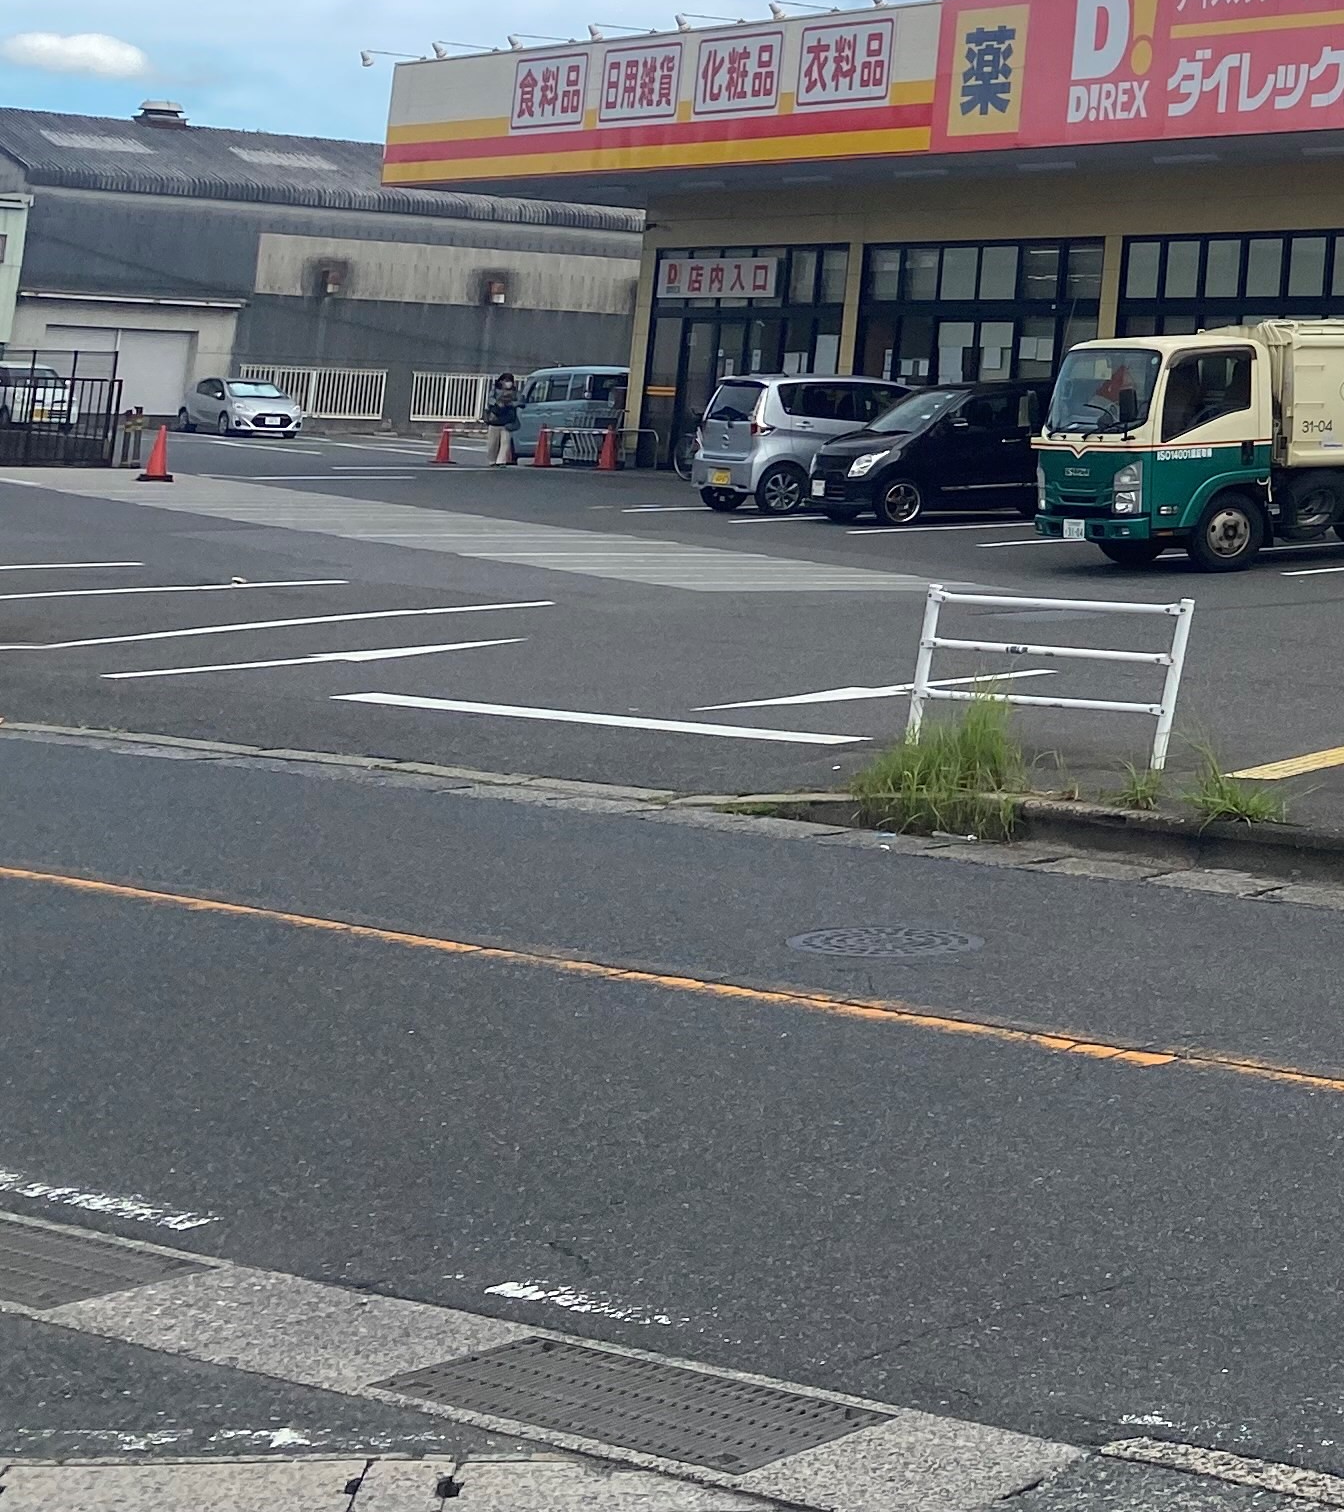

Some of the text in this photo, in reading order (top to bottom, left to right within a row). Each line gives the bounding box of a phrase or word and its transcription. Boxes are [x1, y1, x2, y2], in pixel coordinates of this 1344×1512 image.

[604, 55, 675, 109] 日用雑貨
[701, 44, 775, 104] 化粧品
[804, 32, 885, 94] 衣料品
[959, 24, 1017, 116] 薬
[516, 65, 580, 119] 食料品
[687, 264, 769, 293] 店内入口
[1302, 420, 1333, 433] 31-04
